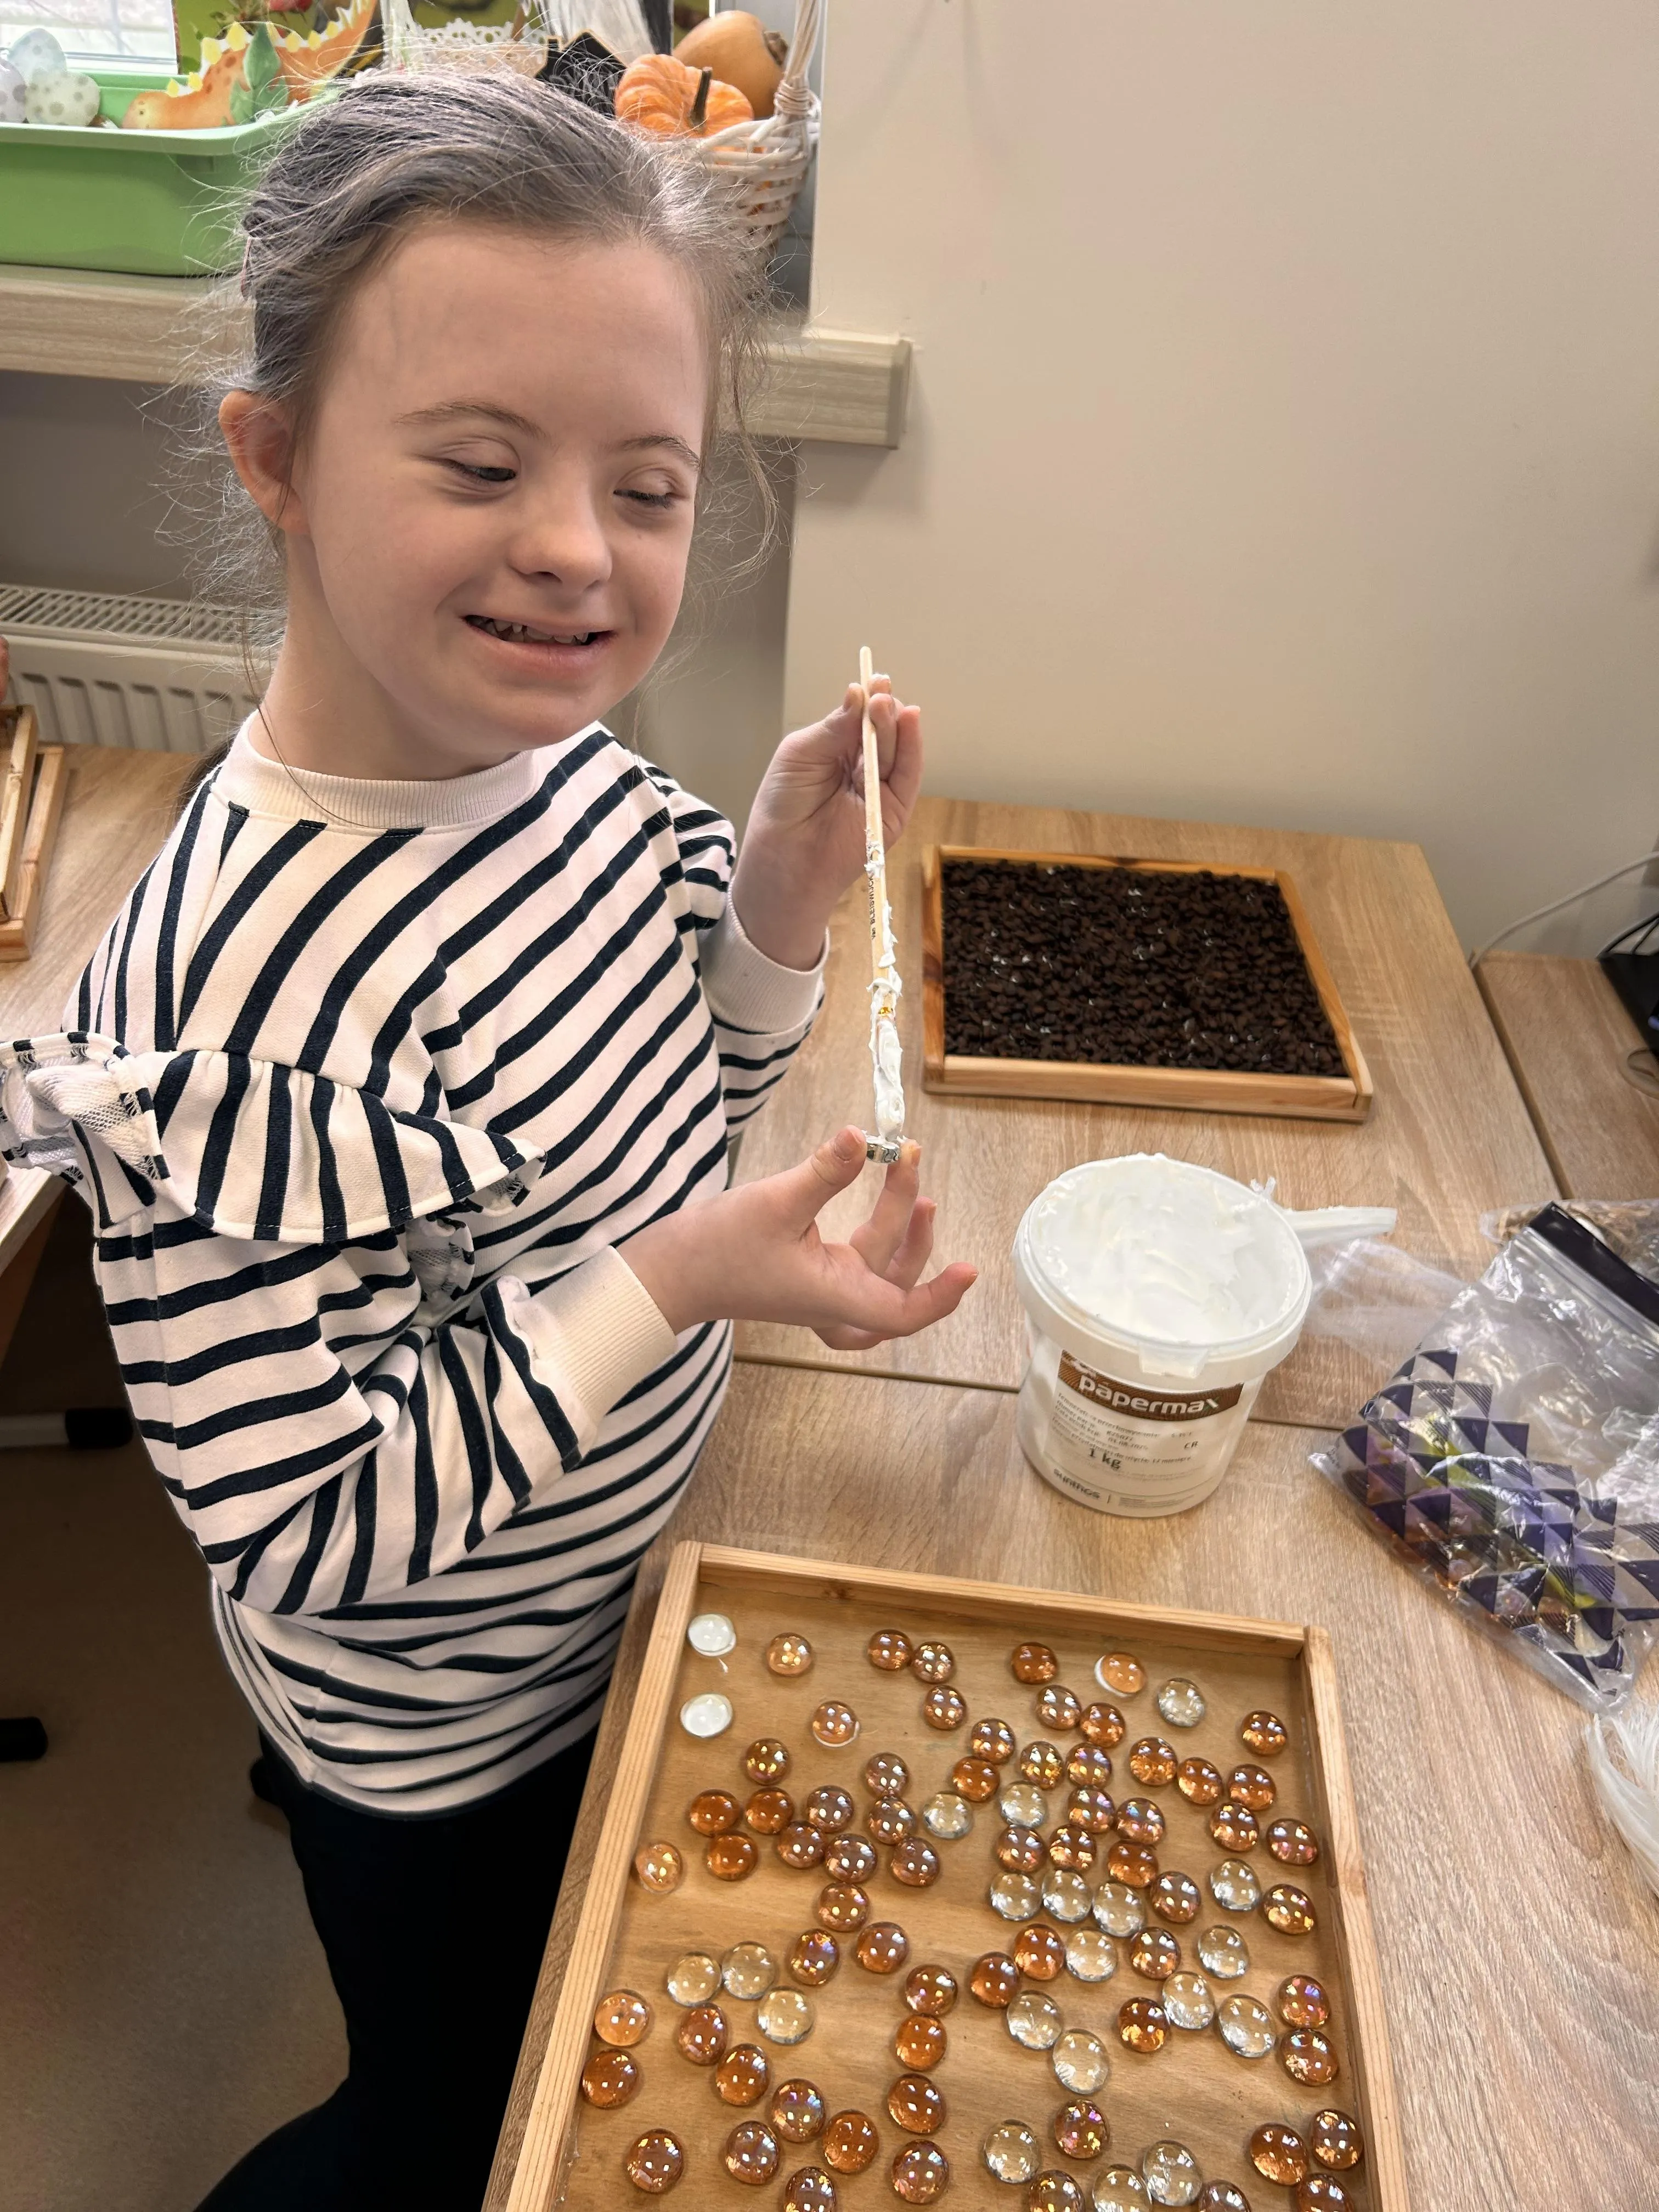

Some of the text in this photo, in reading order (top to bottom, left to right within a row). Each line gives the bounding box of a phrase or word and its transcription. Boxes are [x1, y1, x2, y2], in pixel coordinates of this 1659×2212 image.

[1079, 1375, 1220, 1415] papermax
[1089, 1448, 1122, 1471] 1 kg
